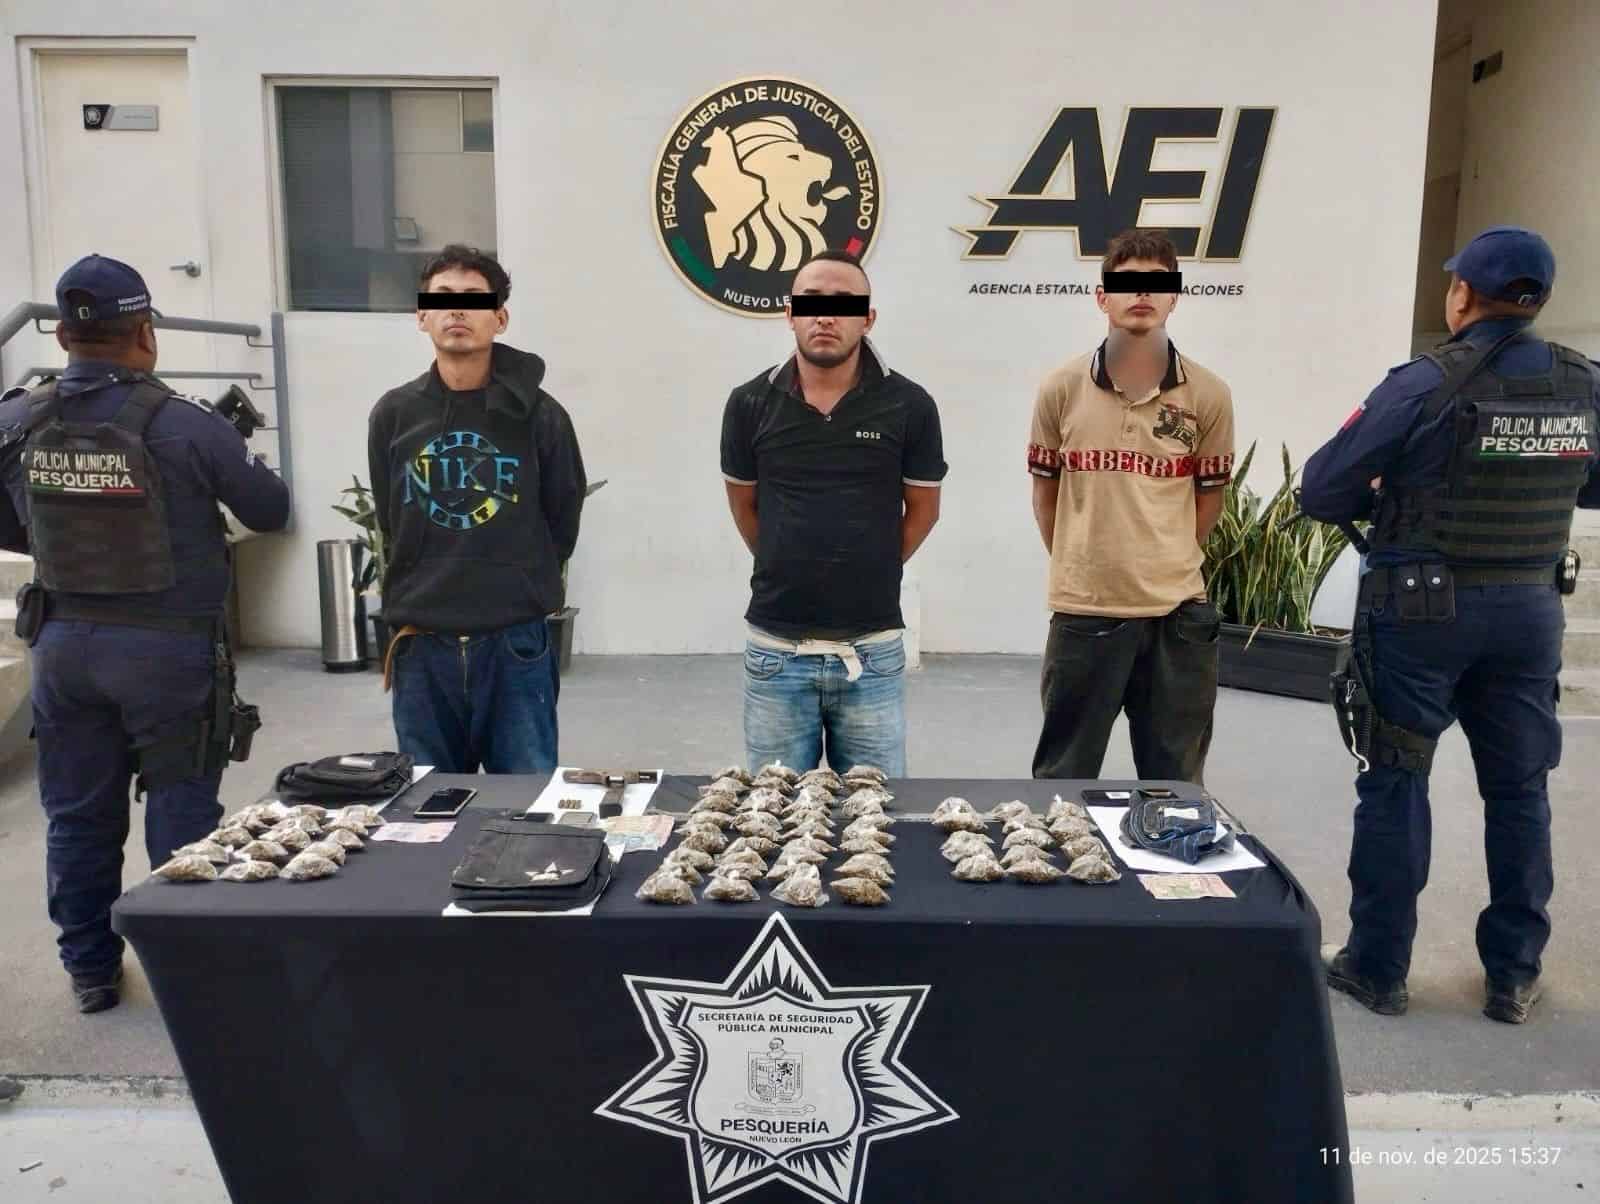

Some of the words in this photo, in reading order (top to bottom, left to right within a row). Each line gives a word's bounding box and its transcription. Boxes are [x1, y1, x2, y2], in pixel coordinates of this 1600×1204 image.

[661, 153, 684, 229] FISCALÍA
[675, 92, 743, 151] GENERAL
[744, 86, 769, 103] DE
[771, 87, 841, 129] JUSTICIA
[838, 124, 863, 159] DEL
[856, 159, 874, 230] ESTADO
[949, 105, 1278, 261] AEI
[723, 288, 770, 308] NUEVO
[969, 283, 1032, 295] AGENCIA
[1035, 284, 1091, 295] ESTATAL
[1491, 416, 1535, 435] POLICIA
[1540, 416, 1589, 435] MUNICIPAL
[1481, 436, 1588, 451] PESQUERIA
[33, 451, 71, 470] POLICIA
[75, 453, 131, 472] MUNICIPAL
[29, 470, 134, 488] PESQUERIA
[403, 457, 519, 504] NIKE
[698, 1012, 765, 1022] SECRETARÍA
[769, 1013, 783, 1023] DE
[787, 1014, 854, 1025] SEGURIDAD
[718, 1022, 766, 1033] PÚBLICA
[770, 1024, 834, 1034] MUNICIPAL
[720, 1118, 830, 1135] PESQUERÍA
